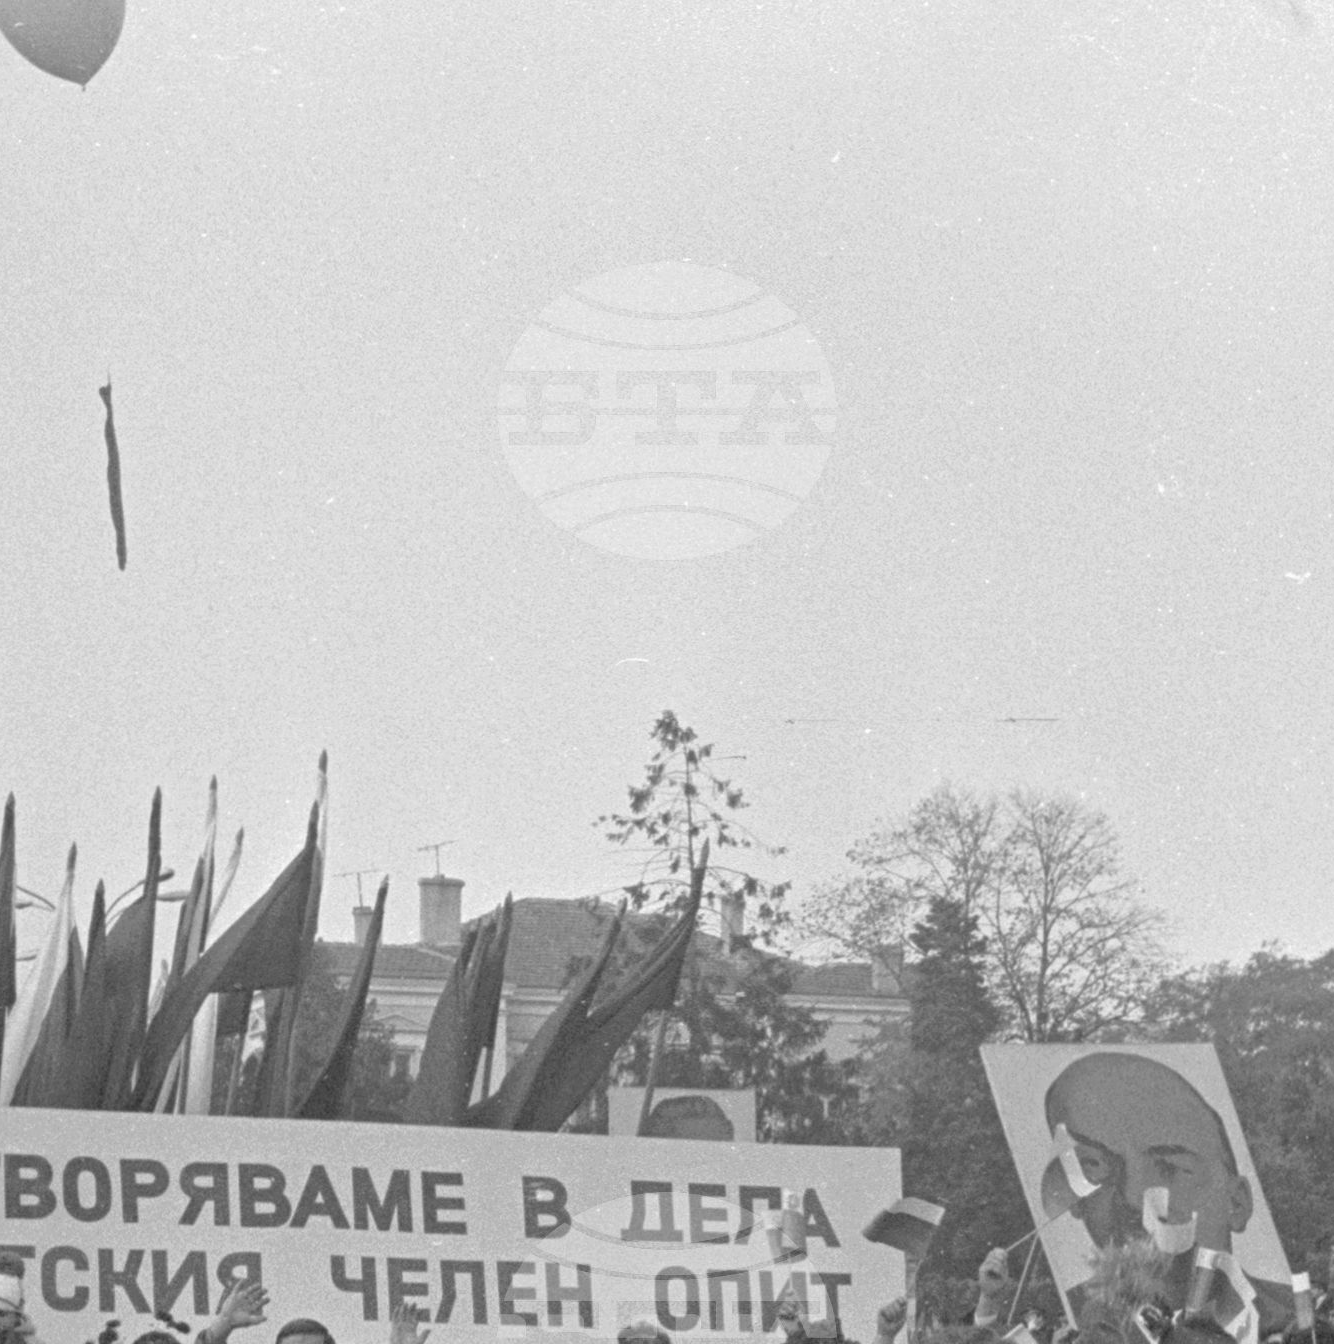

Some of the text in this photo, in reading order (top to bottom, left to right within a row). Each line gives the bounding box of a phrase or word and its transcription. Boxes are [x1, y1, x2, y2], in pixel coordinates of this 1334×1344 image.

[522, 1174, 573, 1239] В
[620, 1179, 842, 1249] ДЕЛА
[329, 1254, 594, 1329] ЧЕЛЕН
[653, 1265, 853, 1334] ОПИТ
